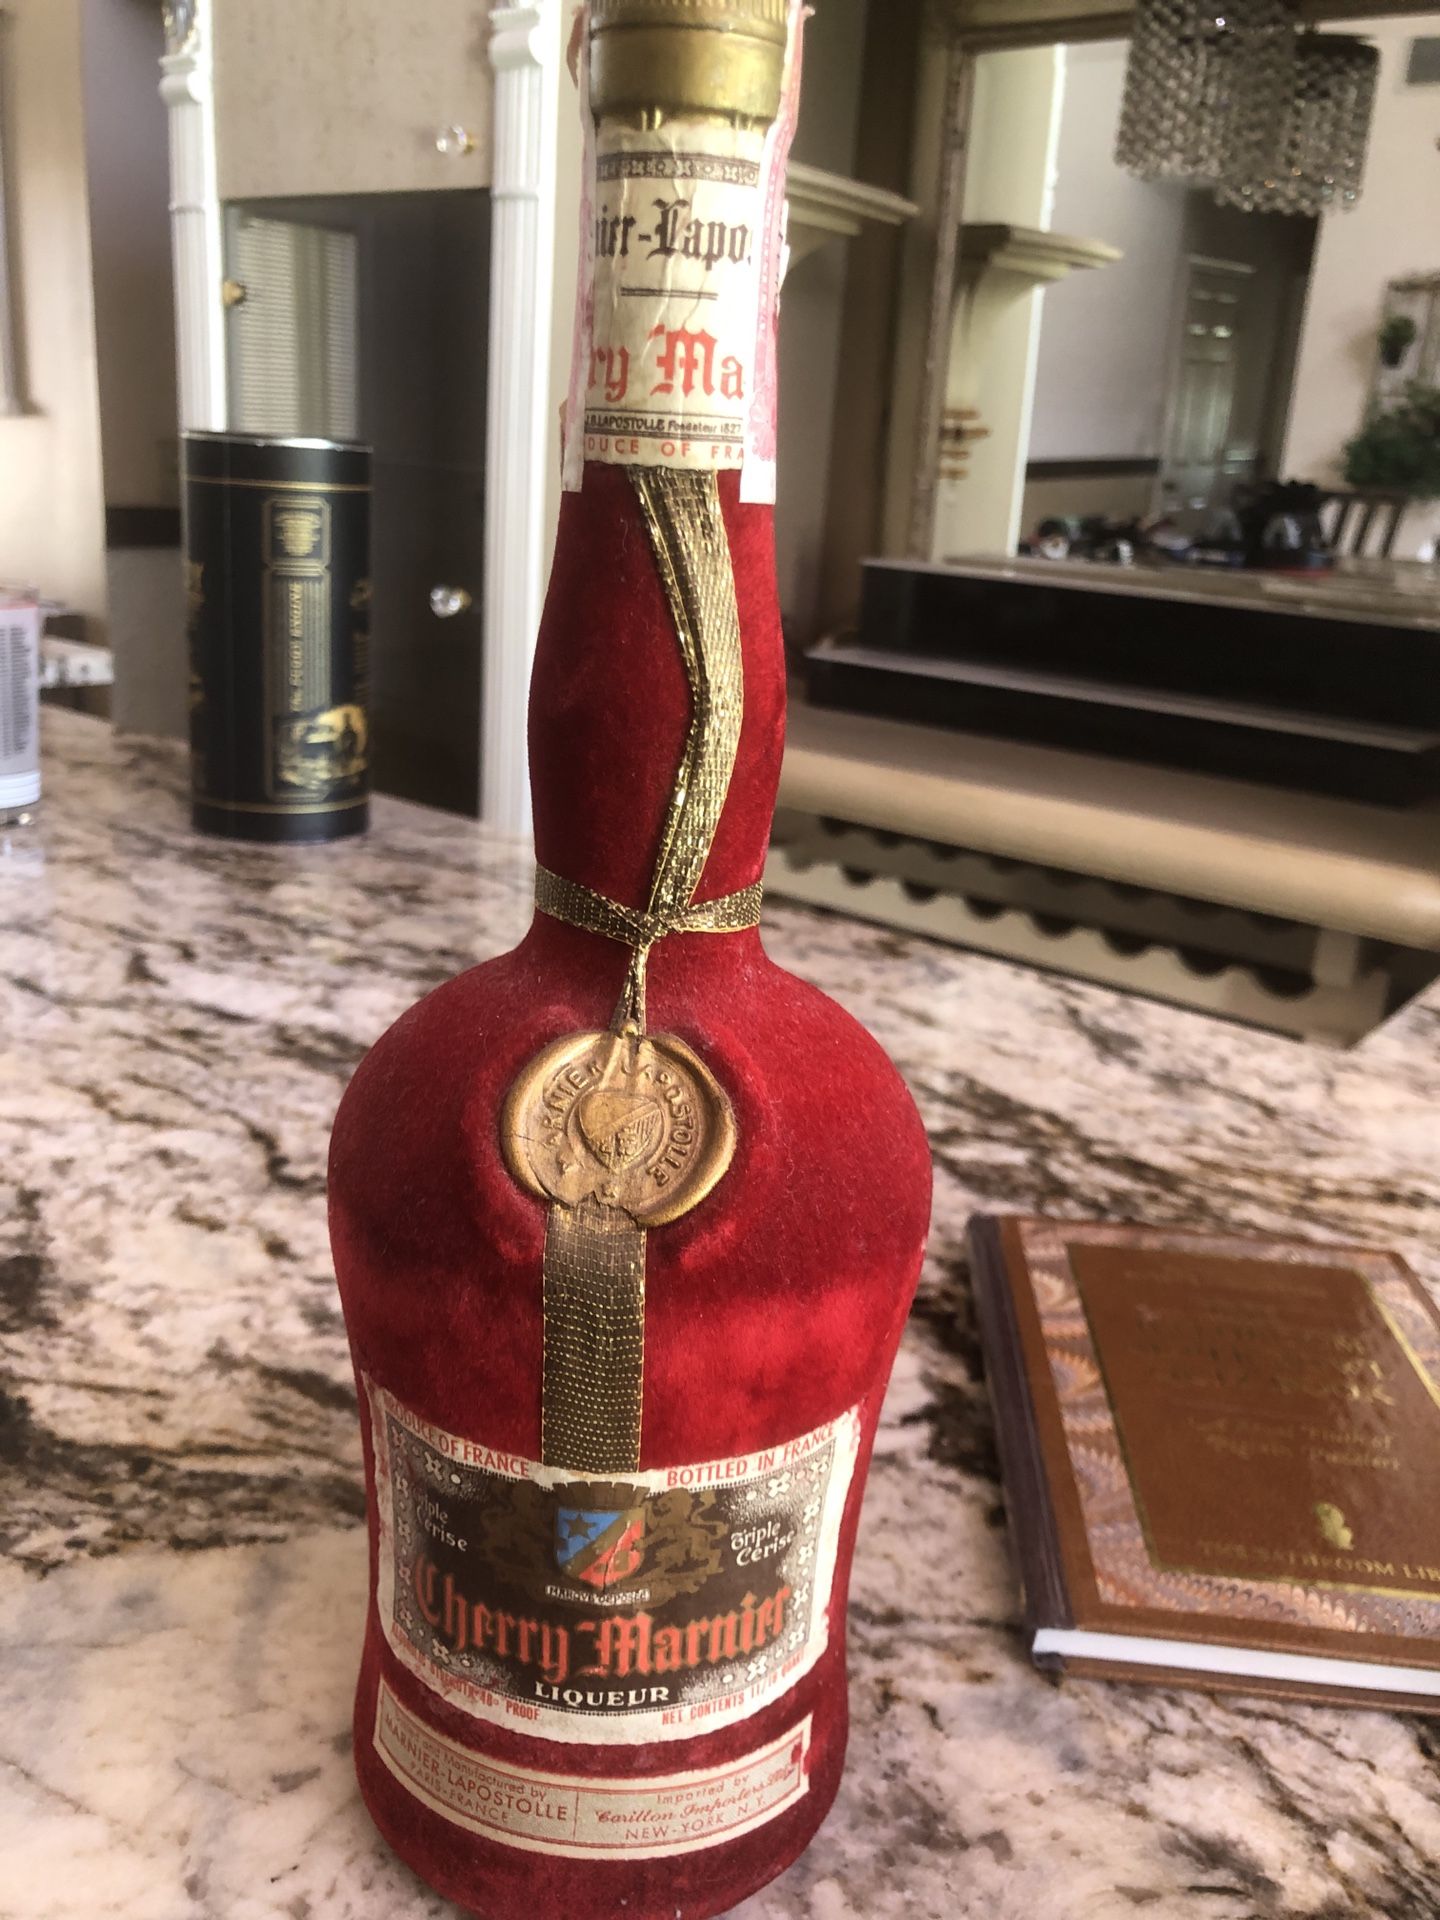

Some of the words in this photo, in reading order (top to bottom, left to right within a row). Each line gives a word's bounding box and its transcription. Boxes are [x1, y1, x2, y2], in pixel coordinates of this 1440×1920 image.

[648, 323, 745, 401] Ma
[720, 422, 742, 435] 1827
[588, 437, 640, 455] DUCE
[660, 441, 691, 457] OF
[711, 444, 745, 460] FRA
[439, 1435, 459, 1458] OF
[463, 1441, 530, 1478] FRANCE
[666, 1458, 748, 1488] BOTTLED
[757, 1451, 775, 1472] IN
[783, 1424, 834, 1464] FRANCE
[730, 1520, 782, 1551] Triple
[736, 1529, 796, 1567] Cerise
[415, 1552, 570, 1684] Cherry
[577, 1584, 792, 1679] Marnier
[505, 1701, 541, 1722] PROOF
[534, 1680, 670, 1708] LIQUEUR
[662, 1709, 682, 1726] NET
[690, 1691, 745, 1719] CONTENTS
[384, 1712, 568, 1822] MARNIER-LAPOSTOLLE
[443, 1751, 526, 1796] Manufactured
[530, 1786, 548, 1802] by
[656, 1781, 725, 1805] Imported
[733, 1774, 750, 1789] by
[594, 1808, 674, 1825] Carillon
